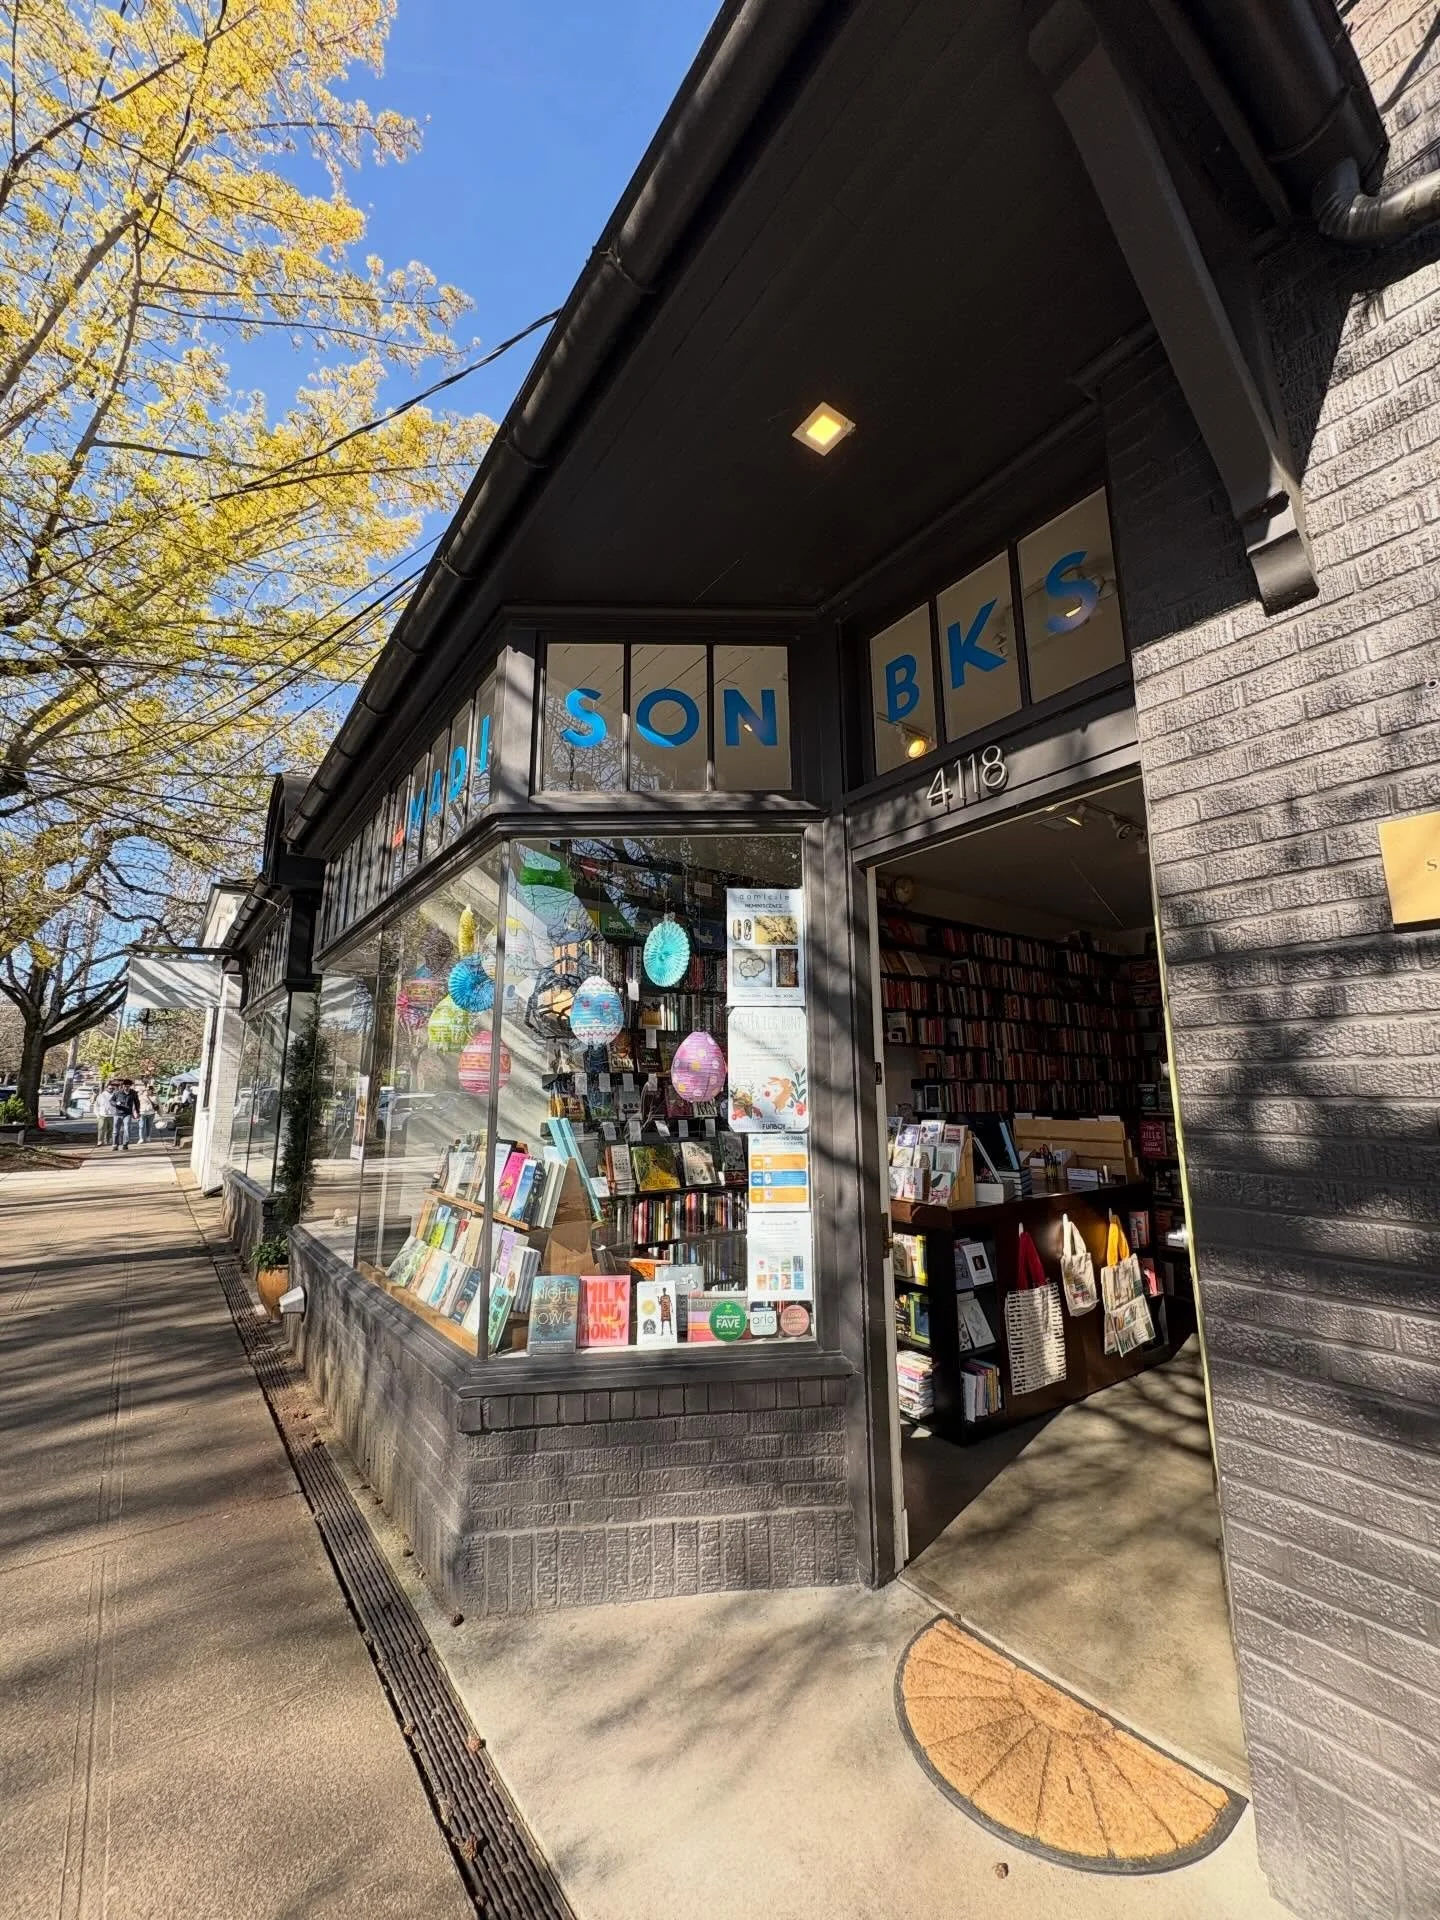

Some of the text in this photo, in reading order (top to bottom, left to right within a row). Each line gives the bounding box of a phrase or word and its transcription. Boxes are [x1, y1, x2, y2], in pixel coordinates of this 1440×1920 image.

[886, 551, 1098, 724] BKS
[927, 745, 1006, 806] 4118
[535, 1286, 575, 1302] NIGHT
[584, 1281, 627, 1302] MILK
[538, 1311, 570, 1325] OWL
[589, 1303, 623, 1323] AND
[752, 1314, 775, 1325] arlo
[581, 1323, 626, 1340] HONEY
[716, 1319, 740, 1329] FAVE
